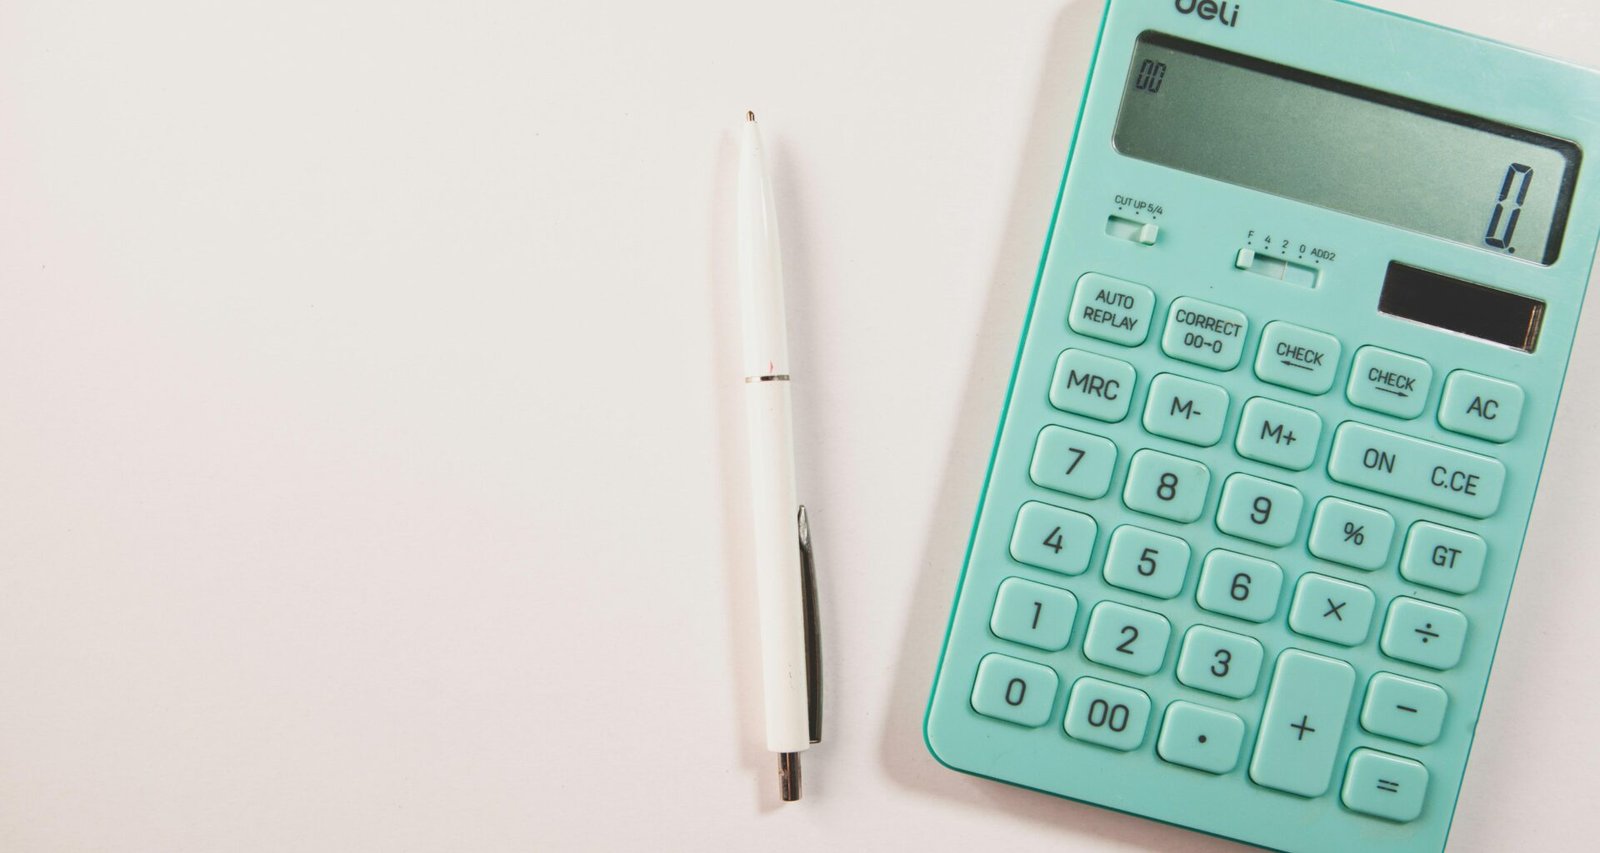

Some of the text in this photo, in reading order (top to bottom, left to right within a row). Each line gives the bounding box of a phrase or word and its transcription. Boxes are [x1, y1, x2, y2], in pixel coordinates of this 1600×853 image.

[1114, 195, 1163, 216] CUT UP 5/4
[1247, 230, 1336, 262] F 4 2 0 ADD2
[1095, 289, 1135, 310] AUTO
[1083, 306, 1138, 331] REPLAY
[1175, 309, 1243, 337] CORRECT
[1276, 342, 1325, 366] CHECK
[1066, 369, 1120, 401] MRC
[1368, 367, 1416, 392] CHECK
[1169, 396, 1201, 420] M-
[1465, 395, 1499, 421] AC
[1260, 420, 1297, 446] M+
[1065, 447, 1086, 475] 7
[1362, 447, 1480, 497] ON C.CE
[1156, 472, 1179, 502] 8
[1250, 495, 1273, 526] 9
[1042, 526, 1063, 555] 4
[1343, 521, 1365, 546] %
[1137, 547, 1159, 577] 5
[1431, 544, 1463, 569] GT
[1230, 572, 1252, 602] 6
[1031, 601, 1043, 630] 1
[1115, 625, 1139, 655] 2
[1210, 648, 1232, 678] 3
[1004, 677, 1027, 707] 0
[1087, 698, 1130, 733] 00
